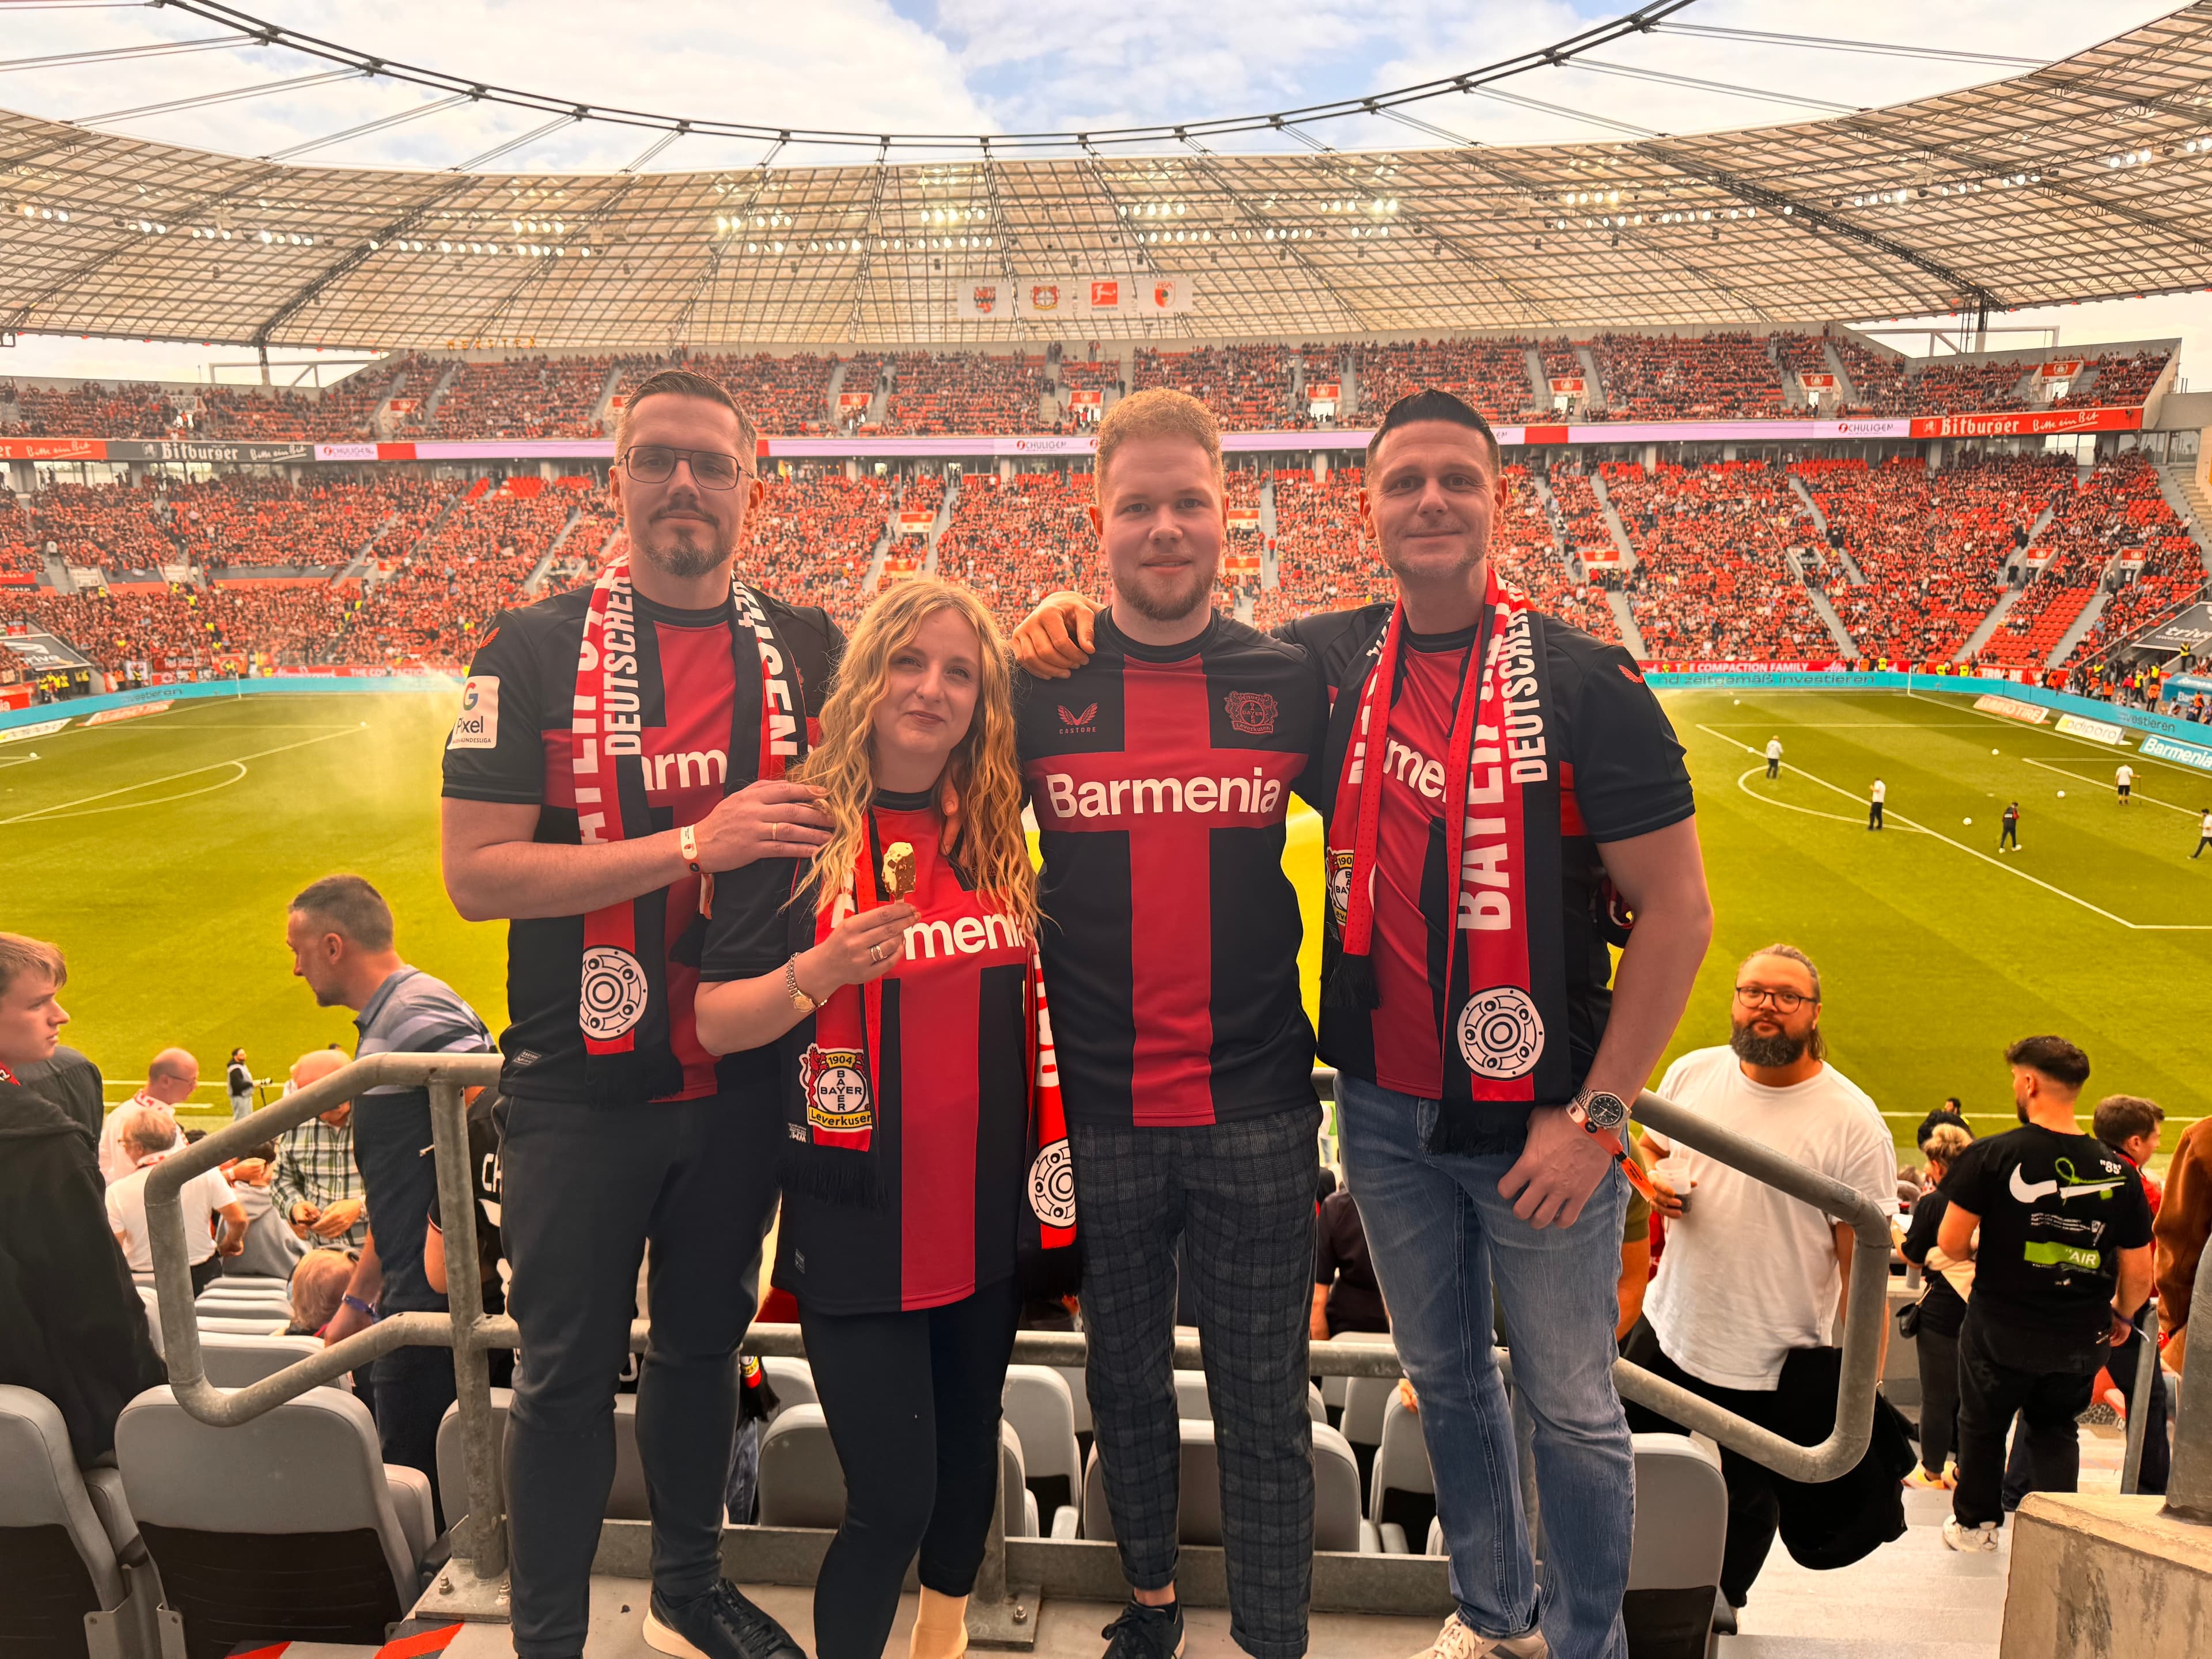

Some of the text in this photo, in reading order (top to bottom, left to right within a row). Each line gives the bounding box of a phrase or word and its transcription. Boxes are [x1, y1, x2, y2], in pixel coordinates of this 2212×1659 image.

[1940, 412, 2099, 437] Bitburger Bitte ein Bit
[161, 442, 238, 460] Bitburger
[1675, 662, 1809, 672] TE COMPACTION FAMILY
[1685, 673, 1774, 687] zeitgemäß
[1779, 674, 1874, 684] investieren
[2017, 706, 2041, 721] TIRE
[456, 715, 483, 734] Pixel
[1059, 726, 1096, 734] CASTORE
[1236, 723, 1270, 732] Leverkusen
[2145, 738, 2212, 768] Barmenia
[1046, 767, 1281, 818] Barmenia
[828, 1055, 853, 1065] 1904
[820, 1086, 862, 1094] BAYER
[837, 1070, 845, 1111] BAYER
